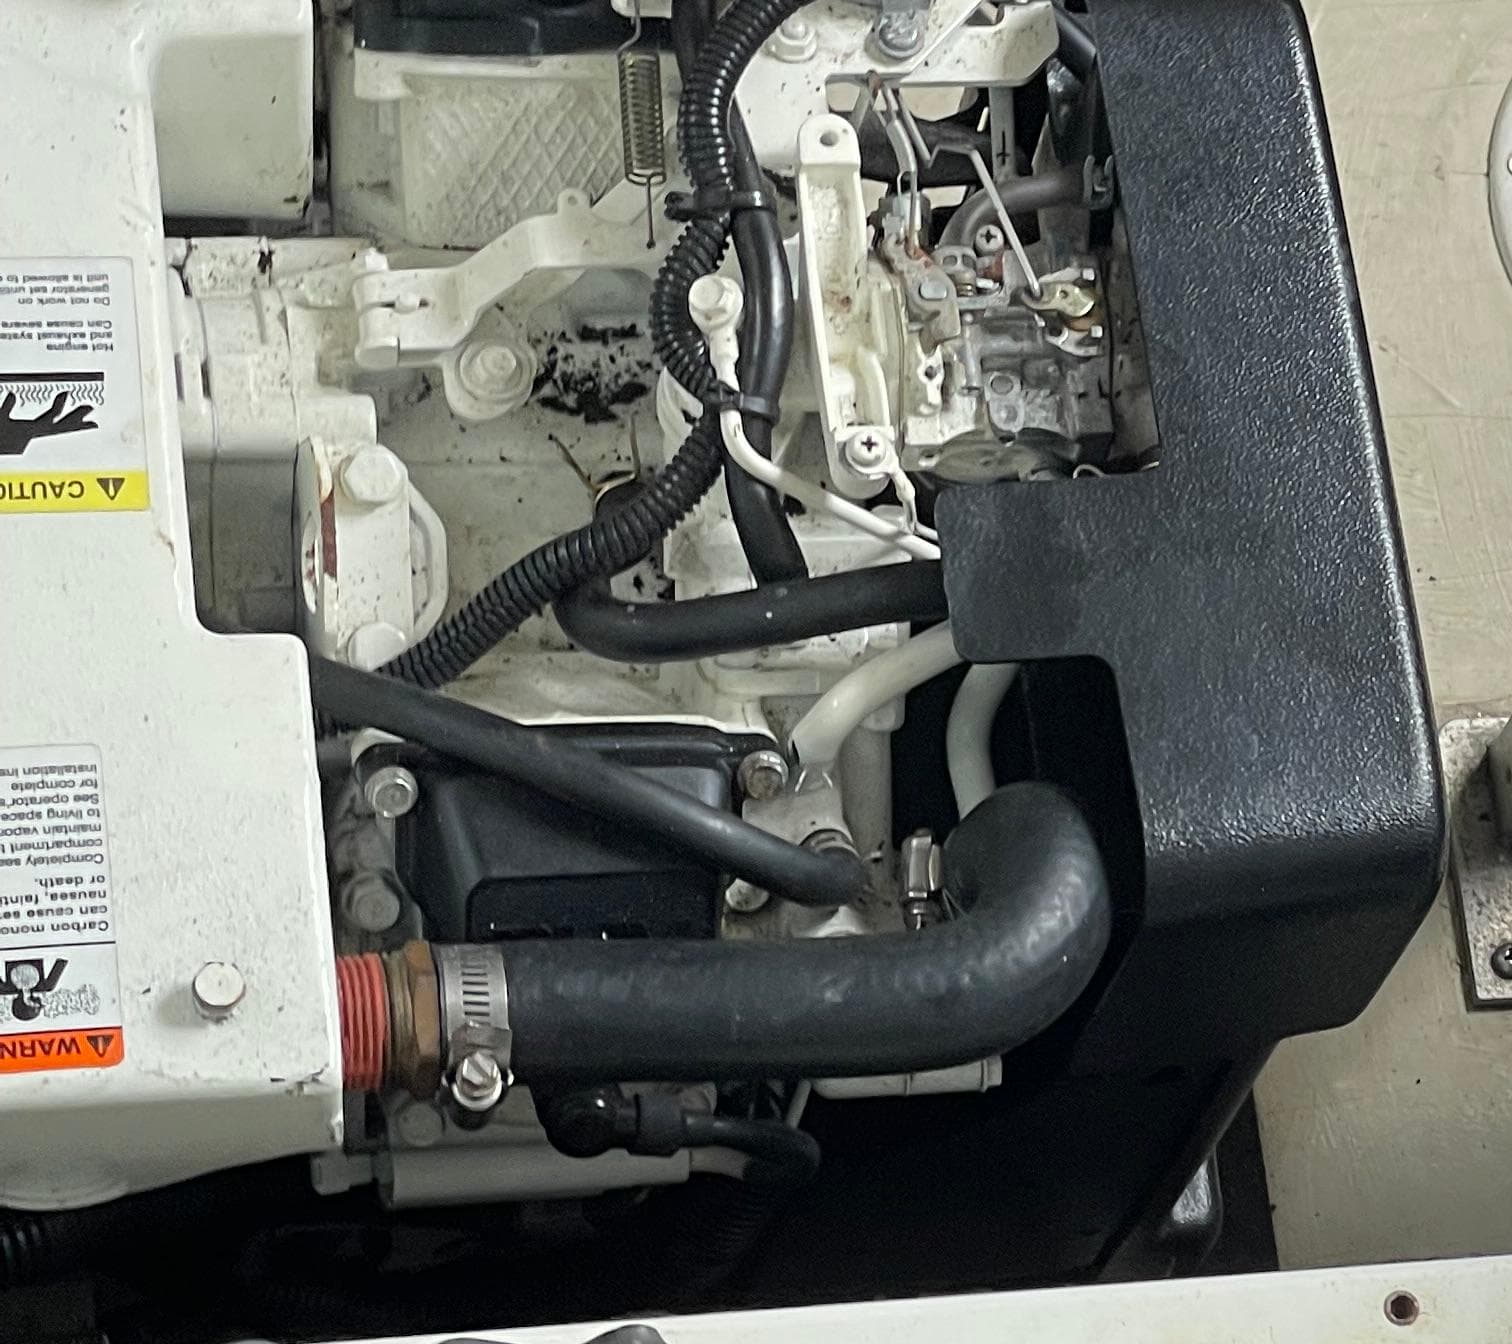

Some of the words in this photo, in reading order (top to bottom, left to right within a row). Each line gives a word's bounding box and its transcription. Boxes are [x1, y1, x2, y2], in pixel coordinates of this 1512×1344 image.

[7, 275, 18, 283] to
[23, 275, 68, 283] allowed
[87, 274, 108, 282] unit
[30, 286, 47, 294] set
[52, 284, 109, 294] generator
[37, 298, 66, 306] work
[71, 297, 89, 305] not
[94, 297, 110, 306] Do
[88, 320, 112, 330] Can
[37, 332, 86, 340] exhaust
[90, 332, 112, 340] and
[46, 341, 88, 350] engine
[92, 343, 113, 352] Hot
[23, 764, 96, 778] installation
[11, 779, 75, 792] complete
[80, 779, 97, 788] for
[74, 794, 99, 805] See
[47, 808, 83, 820] living
[87, 808, 100, 818] to
[43, 824, 101, 835] maintain
[10, 838, 103, 853] compartment
[26, 854, 103, 867] Completely
[35, 876, 83, 888] death.
[90, 875, 105, 884] or
[45, 890, 106, 901] nausea,
[0, 911, 20, 919] se
[27, 908, 73, 918] cause
[80, 905, 107, 916] can
[51, 921, 108, 932] Carbon
